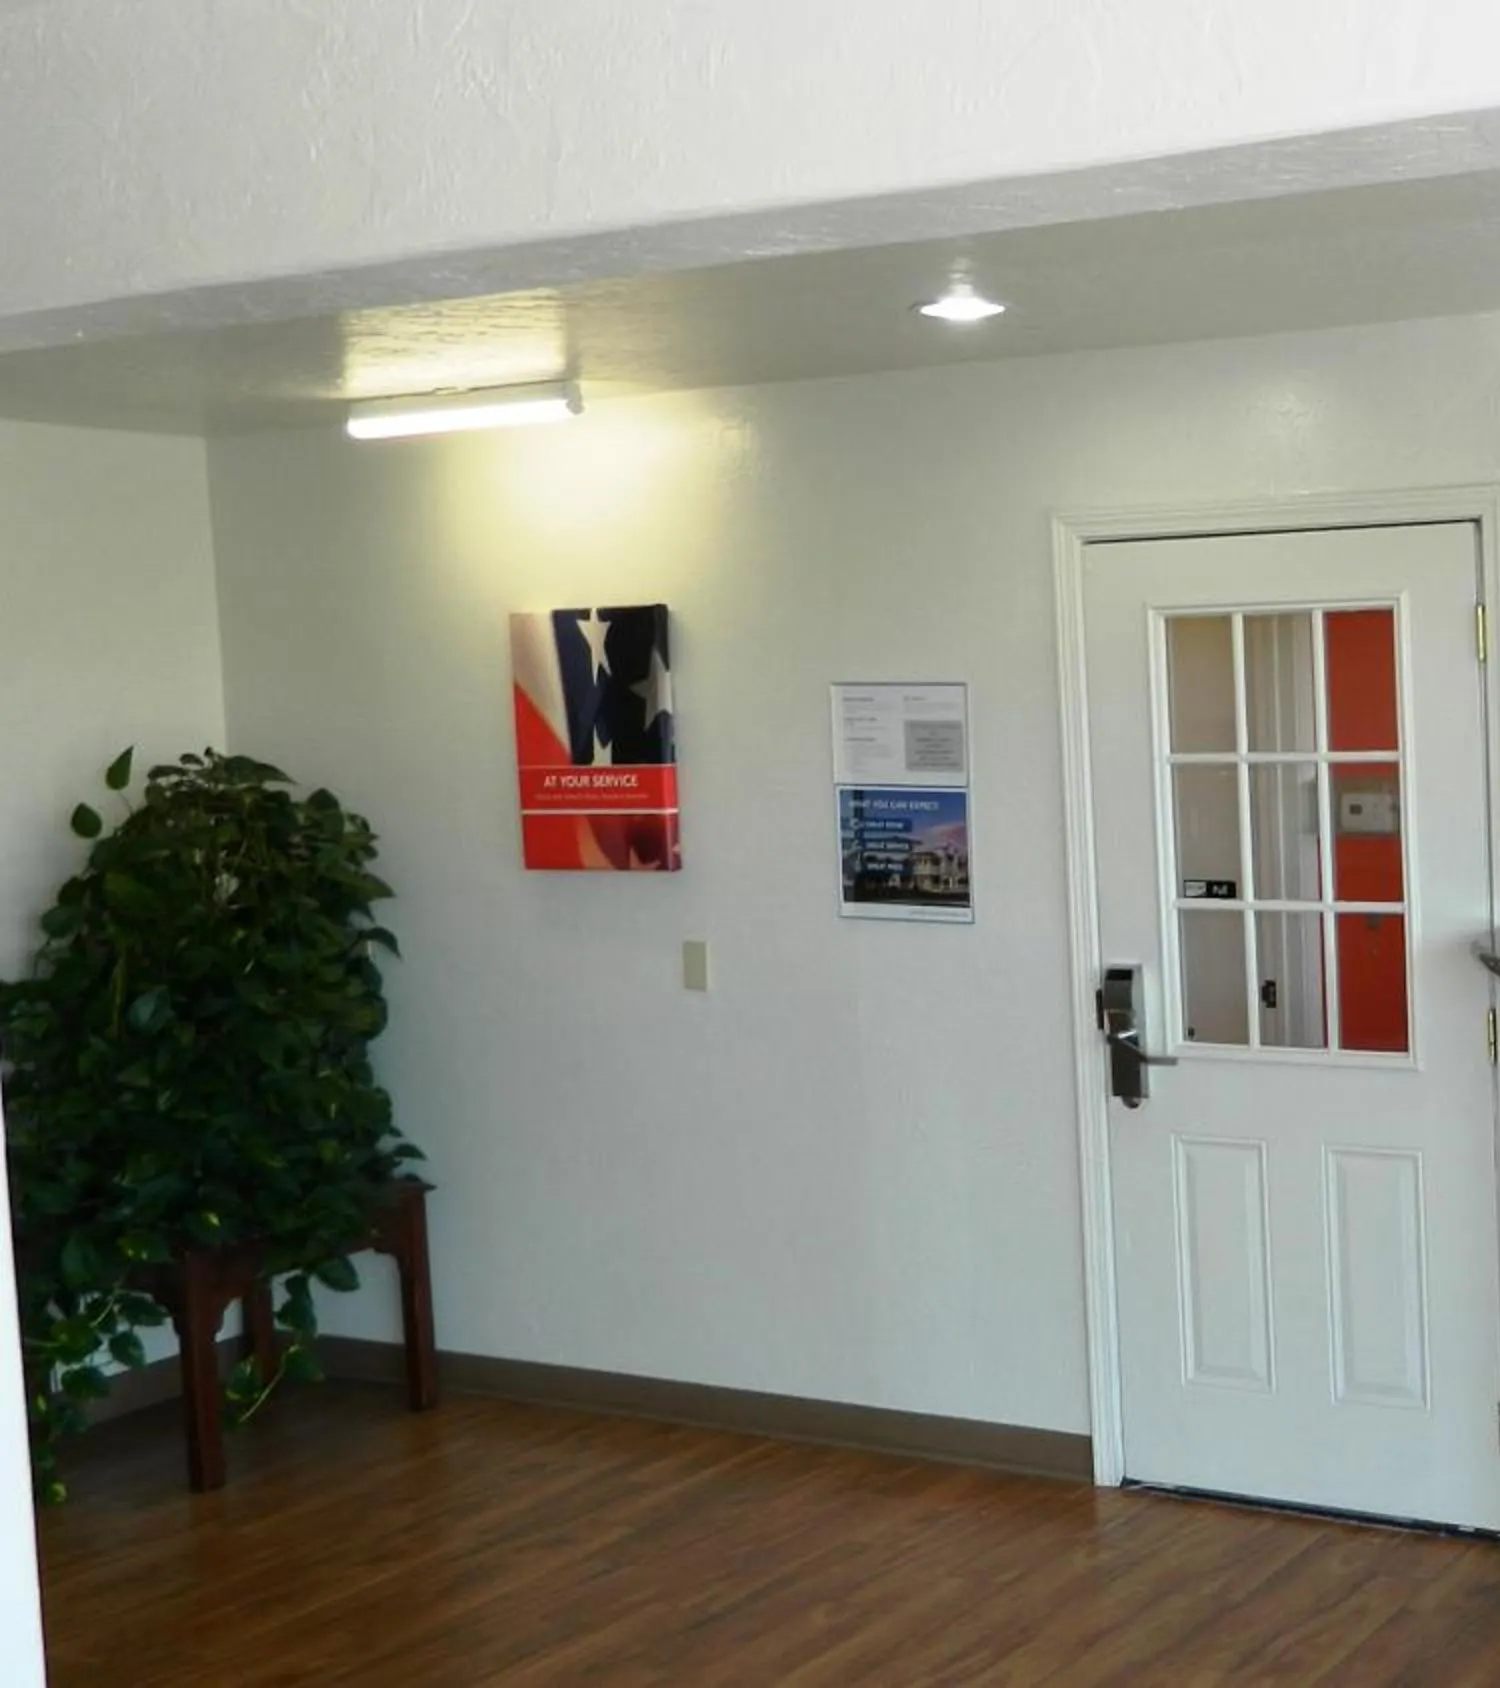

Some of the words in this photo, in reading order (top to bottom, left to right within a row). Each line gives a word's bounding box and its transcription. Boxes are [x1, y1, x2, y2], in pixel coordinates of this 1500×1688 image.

[543, 775, 557, 788] AT
[559, 775, 590, 788] YOUR
[592, 774, 639, 787] SERVICE
